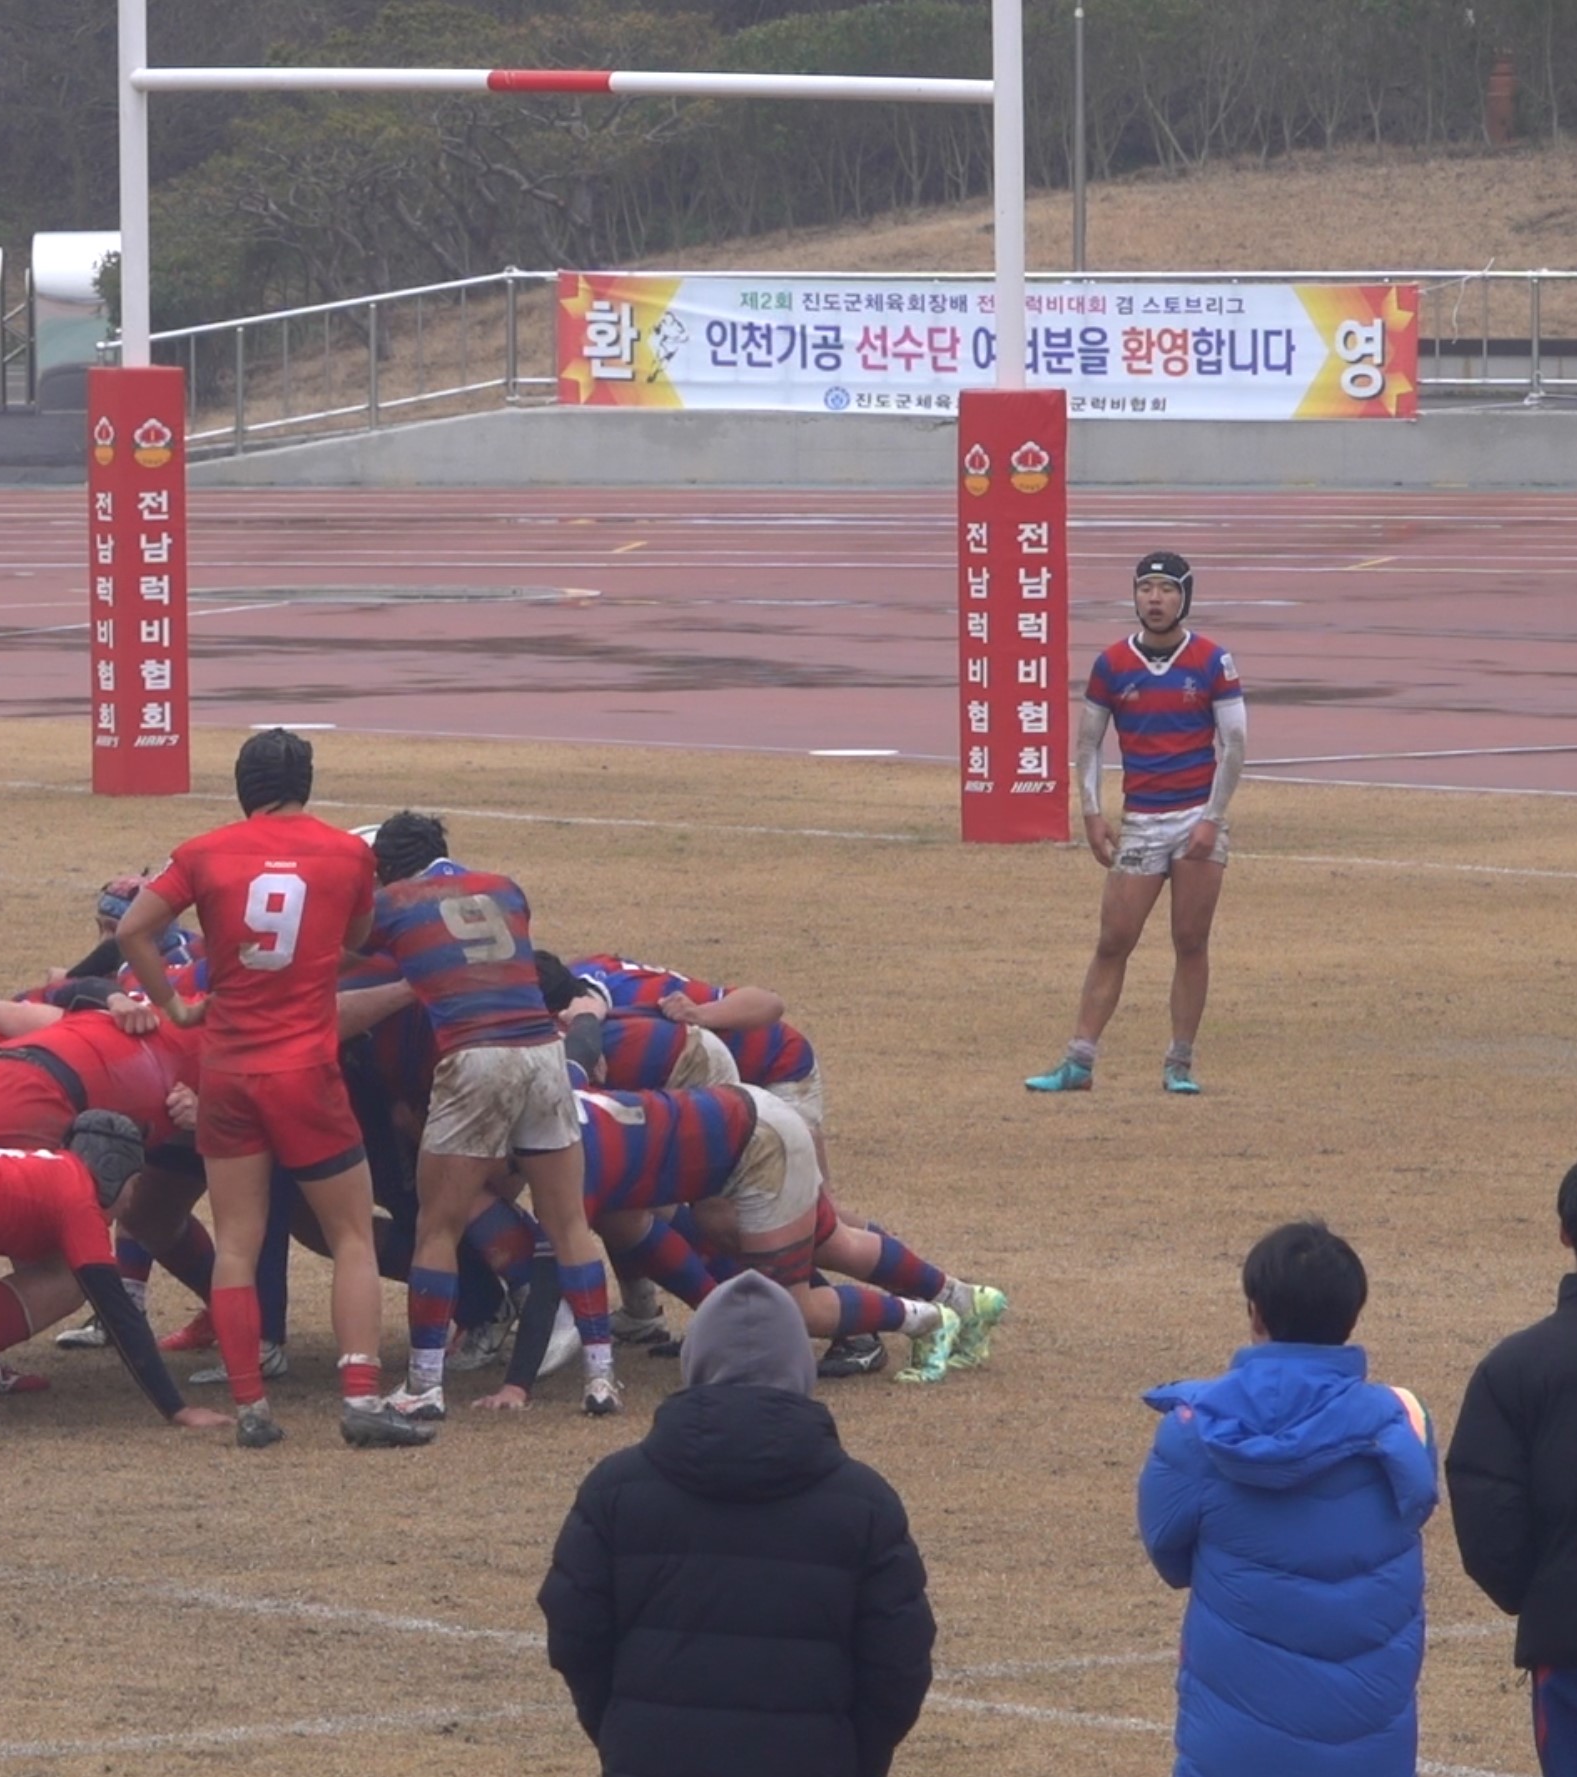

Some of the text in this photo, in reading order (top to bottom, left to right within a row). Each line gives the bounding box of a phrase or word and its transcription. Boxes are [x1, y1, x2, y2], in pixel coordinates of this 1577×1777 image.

[583, 300, 640, 381] 환
[740, 291, 793, 311] 제2회
[802, 293, 969, 314] 진도군체육회장배
[1142, 295, 1246, 315] 스토브리그
[705, 319, 846, 372] 인천기공
[855, 325, 961, 373] 선수단
[1121, 326, 1297, 377] 환영합니다
[1335, 317, 1385, 399] 영
[856, 393, 959, 409] 진도군체육
[136, 489, 174, 733] 전남럭비협회
[965, 521, 991, 779] 전남럭비협회
[1016, 521, 1053, 778] 전남럭비협회
[240, 873, 307, 971] 9
[438, 894, 517, 964] 9
